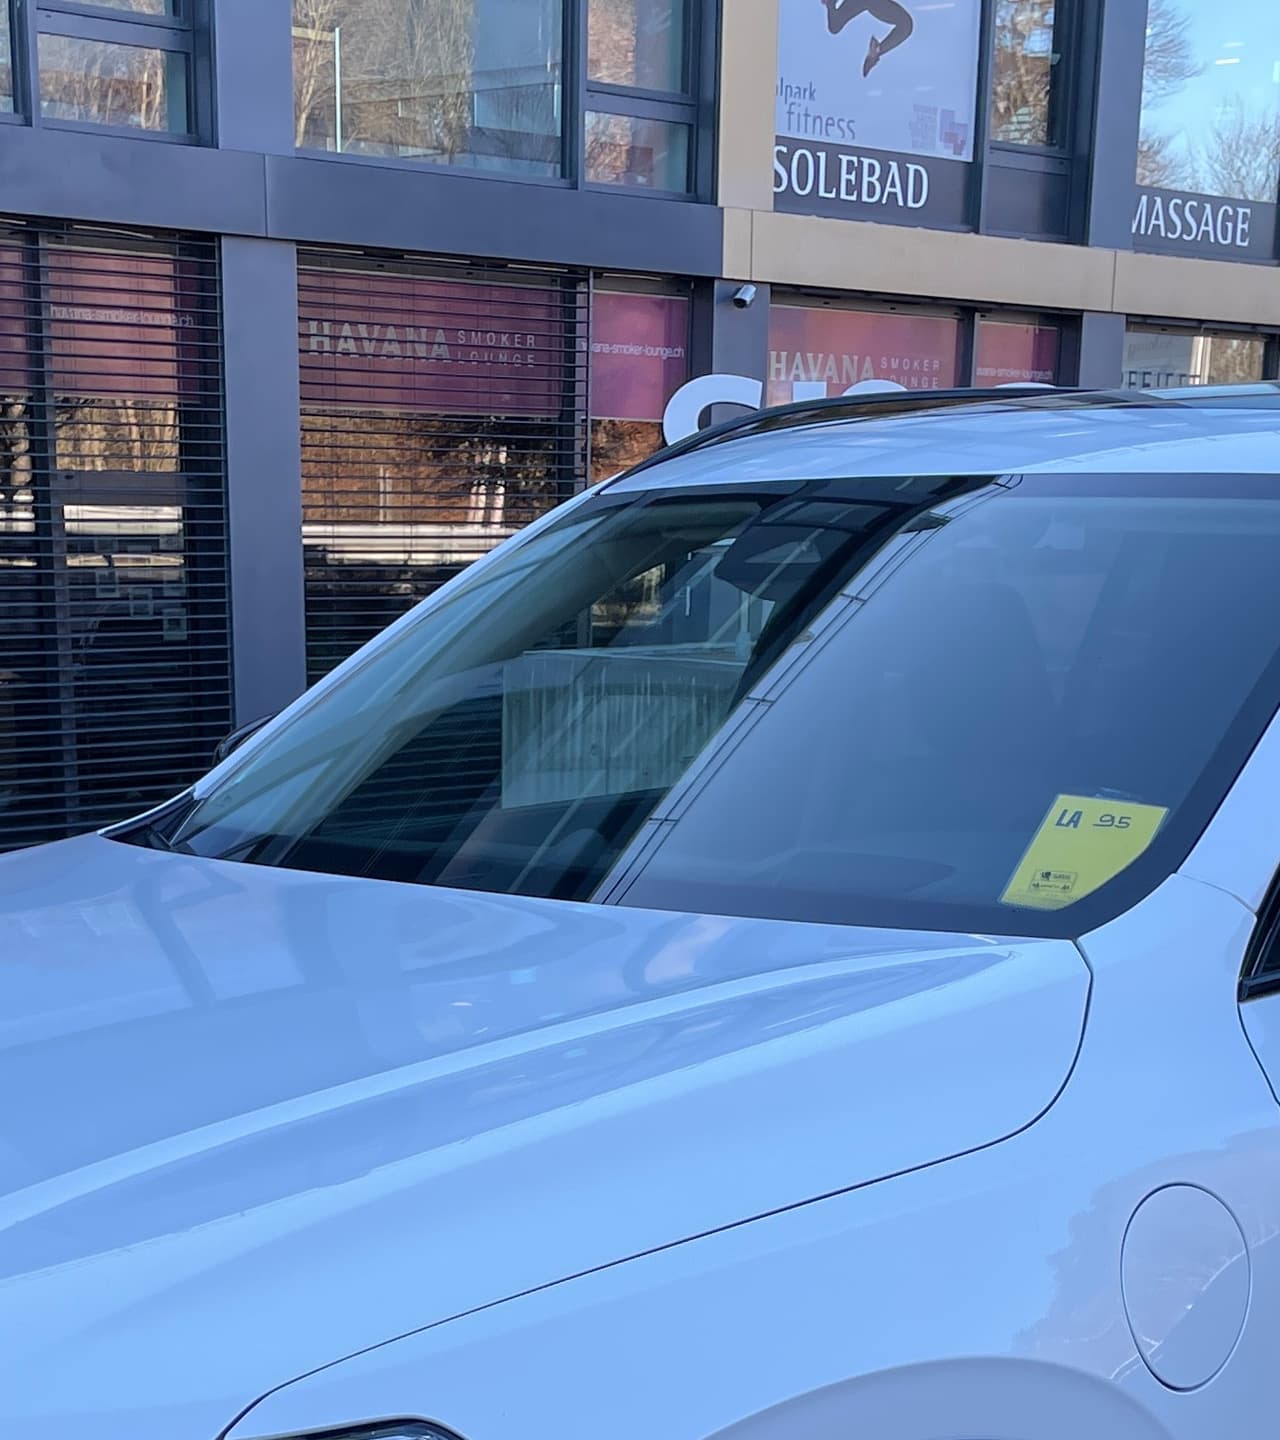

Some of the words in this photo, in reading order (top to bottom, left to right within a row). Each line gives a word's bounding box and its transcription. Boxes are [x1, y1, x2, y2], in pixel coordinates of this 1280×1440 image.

[776, 77, 817, 103] lpark
[786, 101, 857, 141] fitness
[772, 144, 930, 209] SOLEBAD
[308, 320, 454, 363] HAVANA
[457, 329, 537, 348] SMOKER
[768, 350, 875, 385] HAVANA
[880, 356, 941, 372] SMOKER
[1055, 808, 1084, 830] LA
